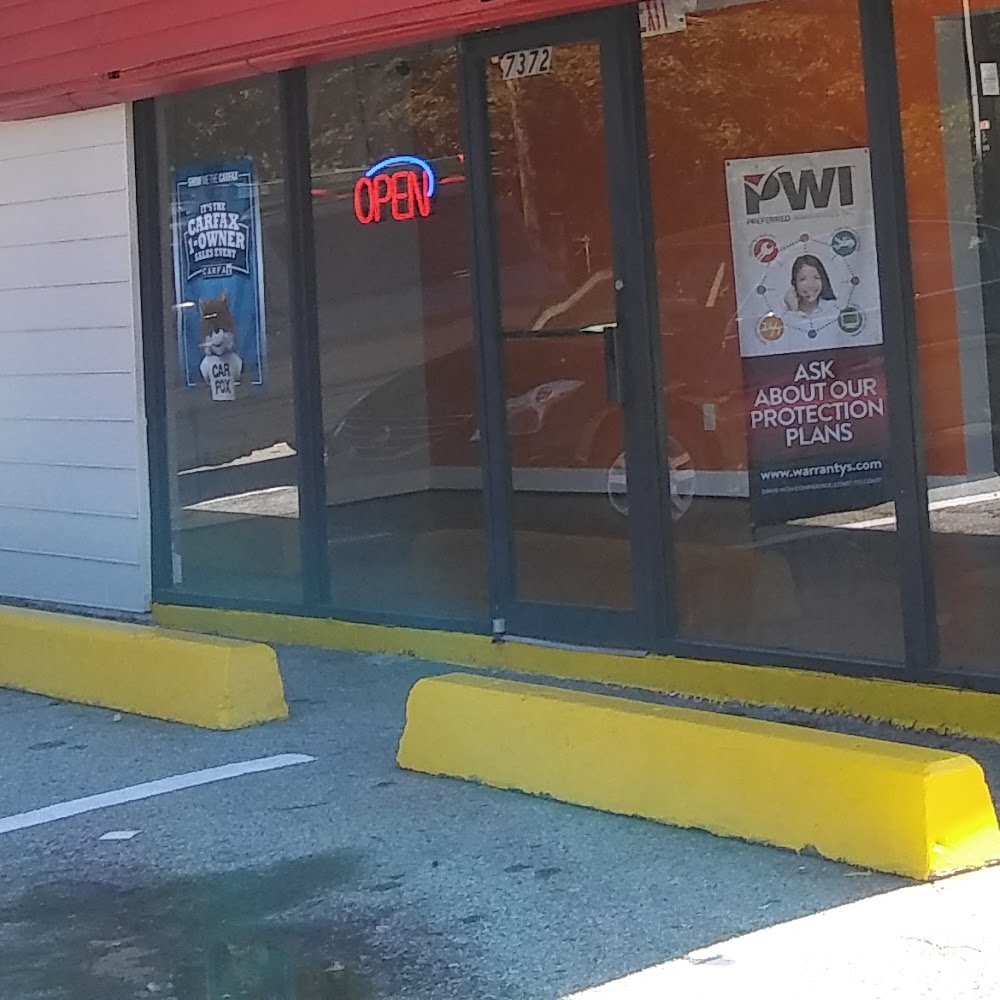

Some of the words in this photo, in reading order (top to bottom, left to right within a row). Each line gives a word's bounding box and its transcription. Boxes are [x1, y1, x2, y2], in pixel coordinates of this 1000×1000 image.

[505, 48, 549, 77] 7372
[354, 170, 431, 224] OPEN
[744, 165, 854, 215] PWI
[187, 213, 240, 236] CARFAX
[188, 230, 245, 255] 1-OWNER
[214, 248, 237, 260] EVENT
[212, 363, 230, 378] CAR
[794, 359, 836, 383] ASK
[215, 379, 232, 395] FOX
[754, 382, 827, 407] ABOUT
[830, 378, 877, 400] OUR
[751, 398, 885, 429] PROTECTION
[786, 423, 853, 447] PLANS
[760, 459, 882, 480] www.warrantys.com
